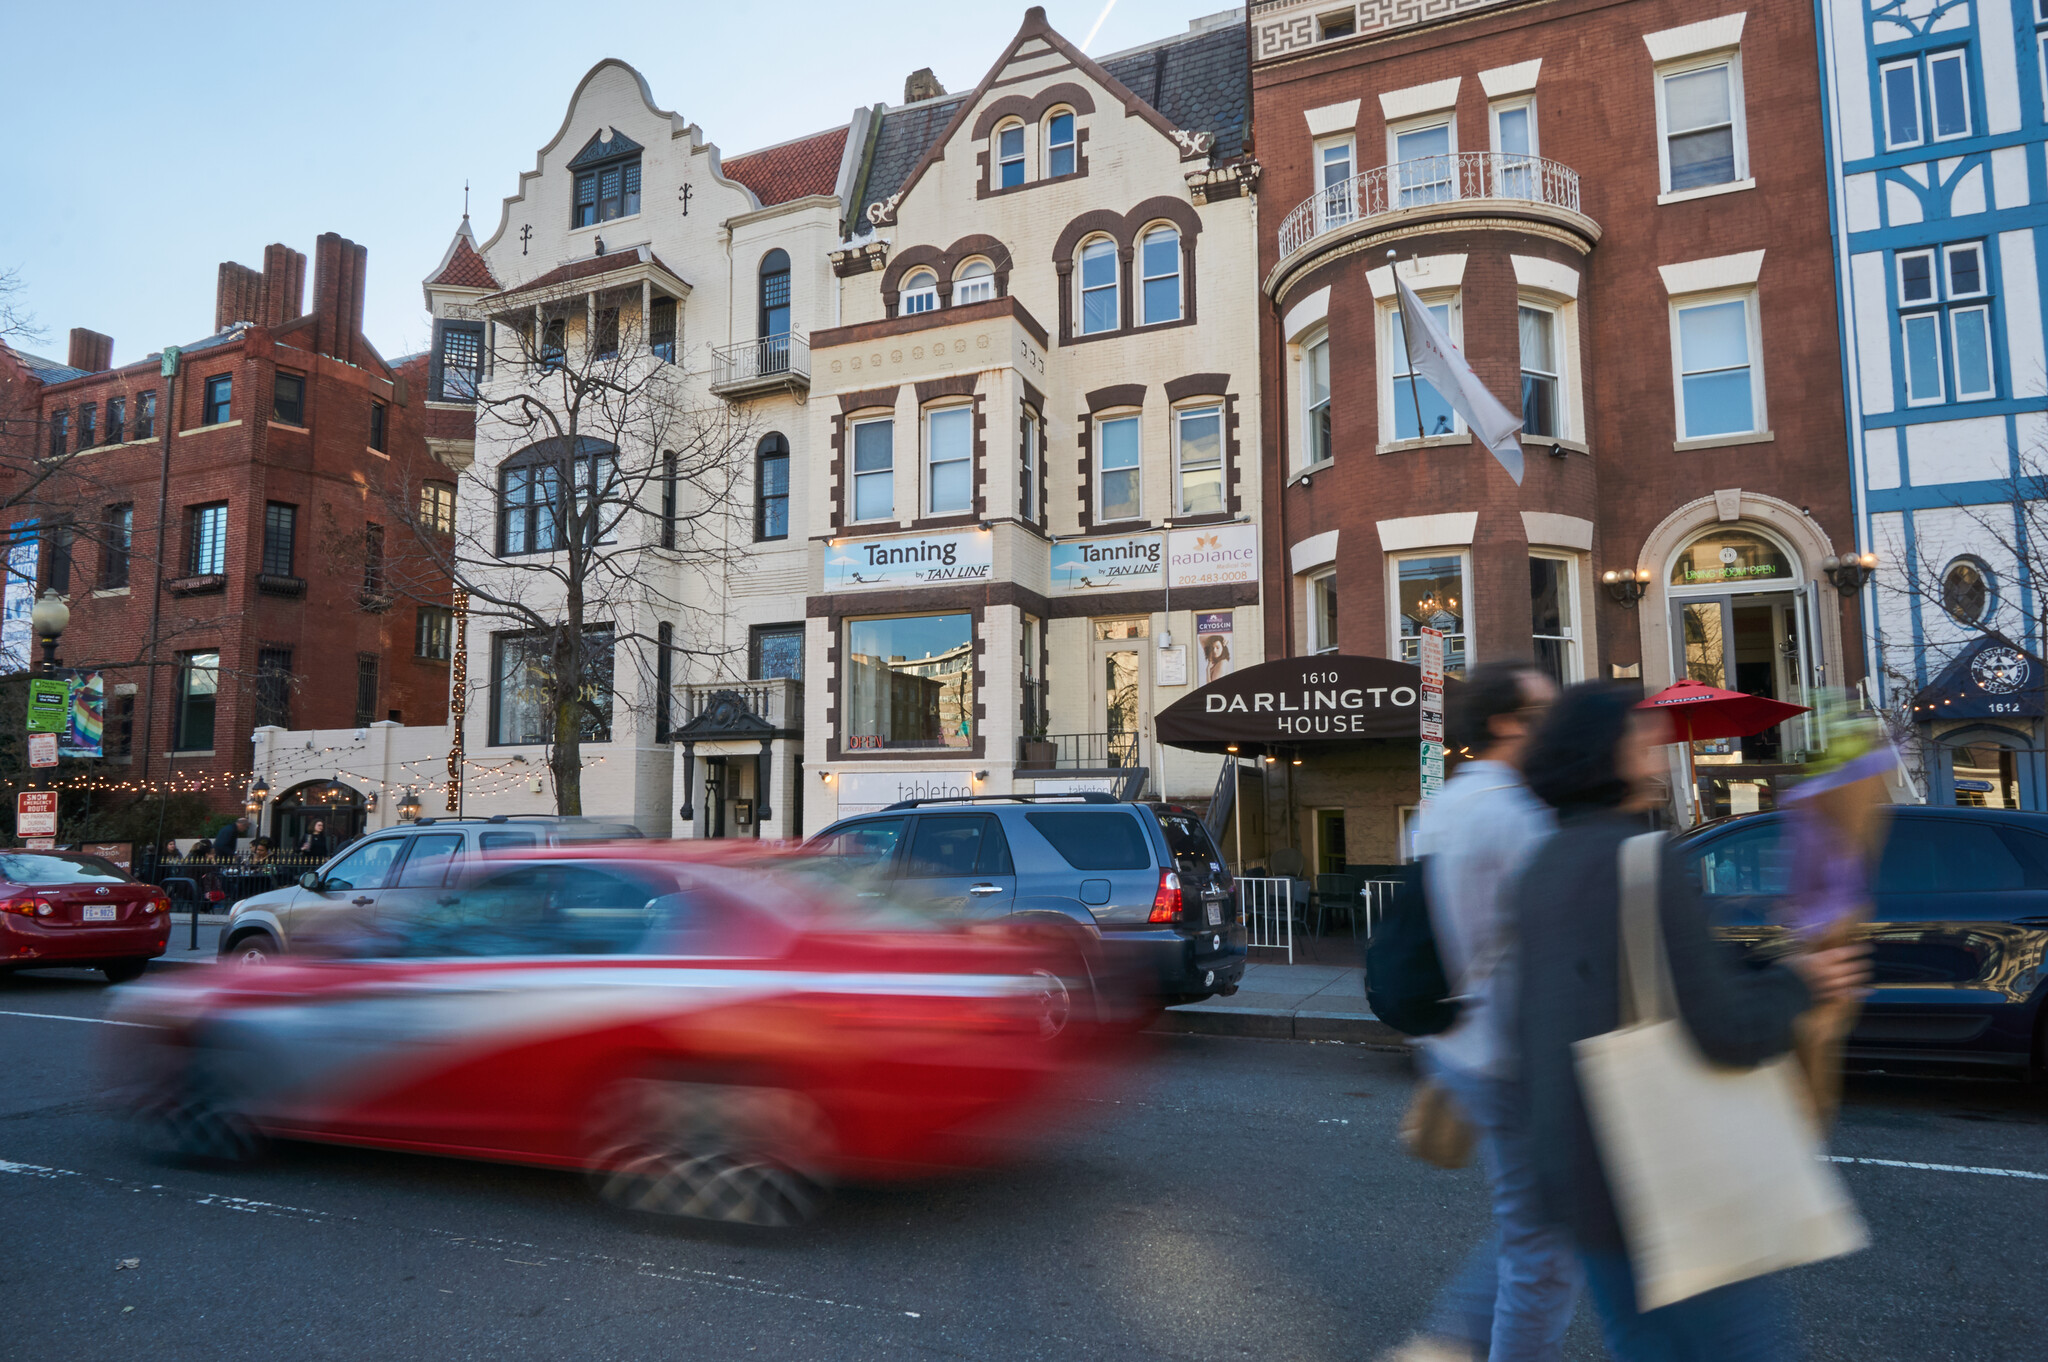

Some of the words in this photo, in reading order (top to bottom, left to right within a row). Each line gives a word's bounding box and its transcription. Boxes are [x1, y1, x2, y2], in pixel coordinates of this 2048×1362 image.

[9, 544, 38, 563] PUBLIC
[863, 540, 957, 566] Tanning
[1079, 541, 1161, 562] Tanning
[8, 561, 37, 582] CITIZEN
[915, 571, 924, 579] by
[928, 567, 955, 579] TAN
[957, 565, 990, 578] LINE
[1108, 565, 1131, 575] TAN
[1133, 563, 1160, 574] LINE
[1685, 569, 1715, 580] DINING
[1718, 567, 1747, 577] ROOM
[1749, 564, 1776, 575] OPEN
[1178, 571, 1248, 585] 202-483-0008
[1301, 672, 1339, 685] 1610
[1206, 686, 1417, 713] DARLINGTO
[1657, 695, 1710, 704] CAMPARI
[1988, 702, 2020, 713] 1612
[1278, 714, 1365, 734] HOUSE
[849, 735, 882, 749] OPEN
[897, 779, 972, 805] tabletop
[27, 805, 48, 813] ROUTE
